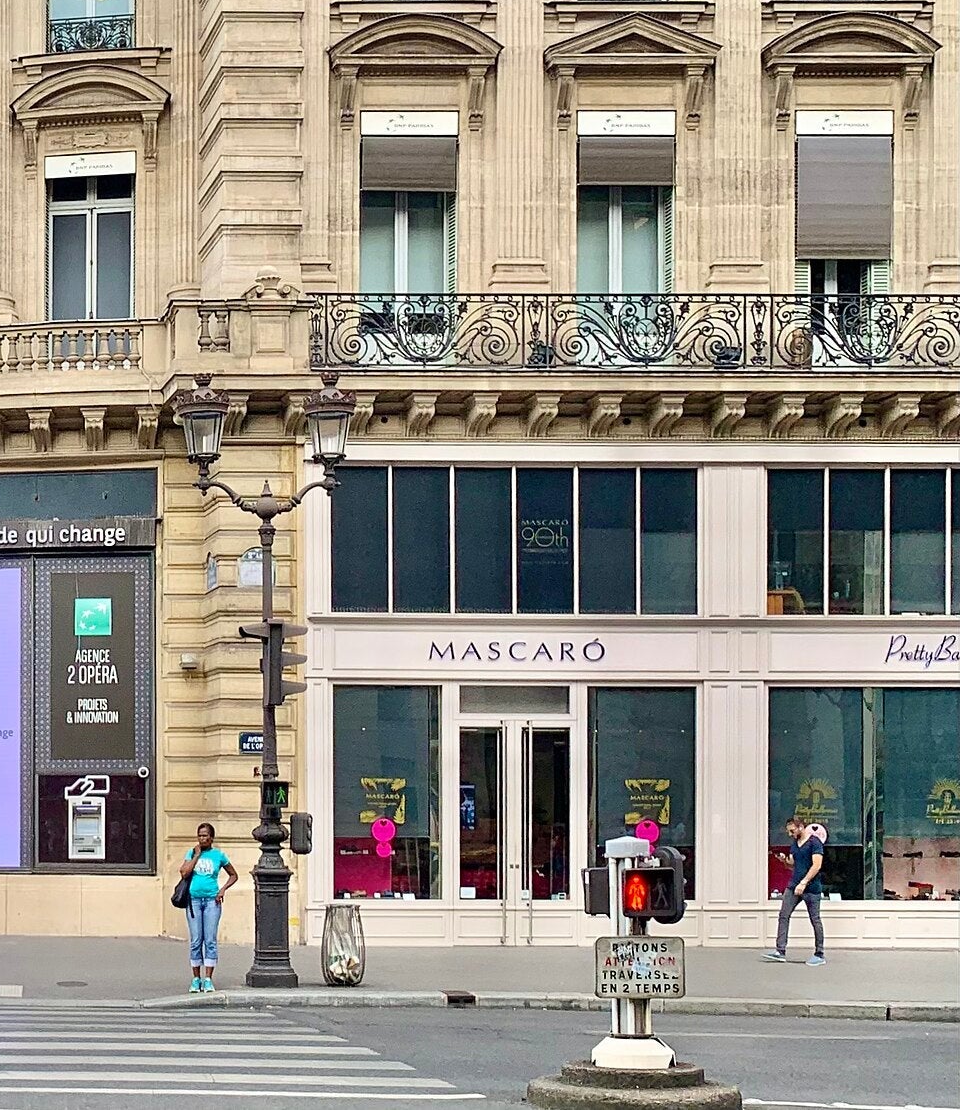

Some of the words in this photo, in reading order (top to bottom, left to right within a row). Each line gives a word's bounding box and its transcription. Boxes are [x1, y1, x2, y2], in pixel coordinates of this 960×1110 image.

[25, 526, 54, 547] qui
[59, 524, 126, 546] change
[521, 526, 569, 548] 90th
[75, 649, 111, 663] AGENCE
[428, 637, 607, 662] MASCARÓ
[67, 664, 76, 684] 2
[78, 662, 119, 684] OPÉRA
[77, 698, 108, 711] PROJETS
[66, 711, 73, 724] &
[74, 711, 119, 724] INNOVATION
[242, 742, 250, 750] DE
[612, 942, 668, 953] PTONS
[601, 983, 617, 994] EN
[622, 983, 630, 994] 2
[635, 983, 680, 994] TEMPS
